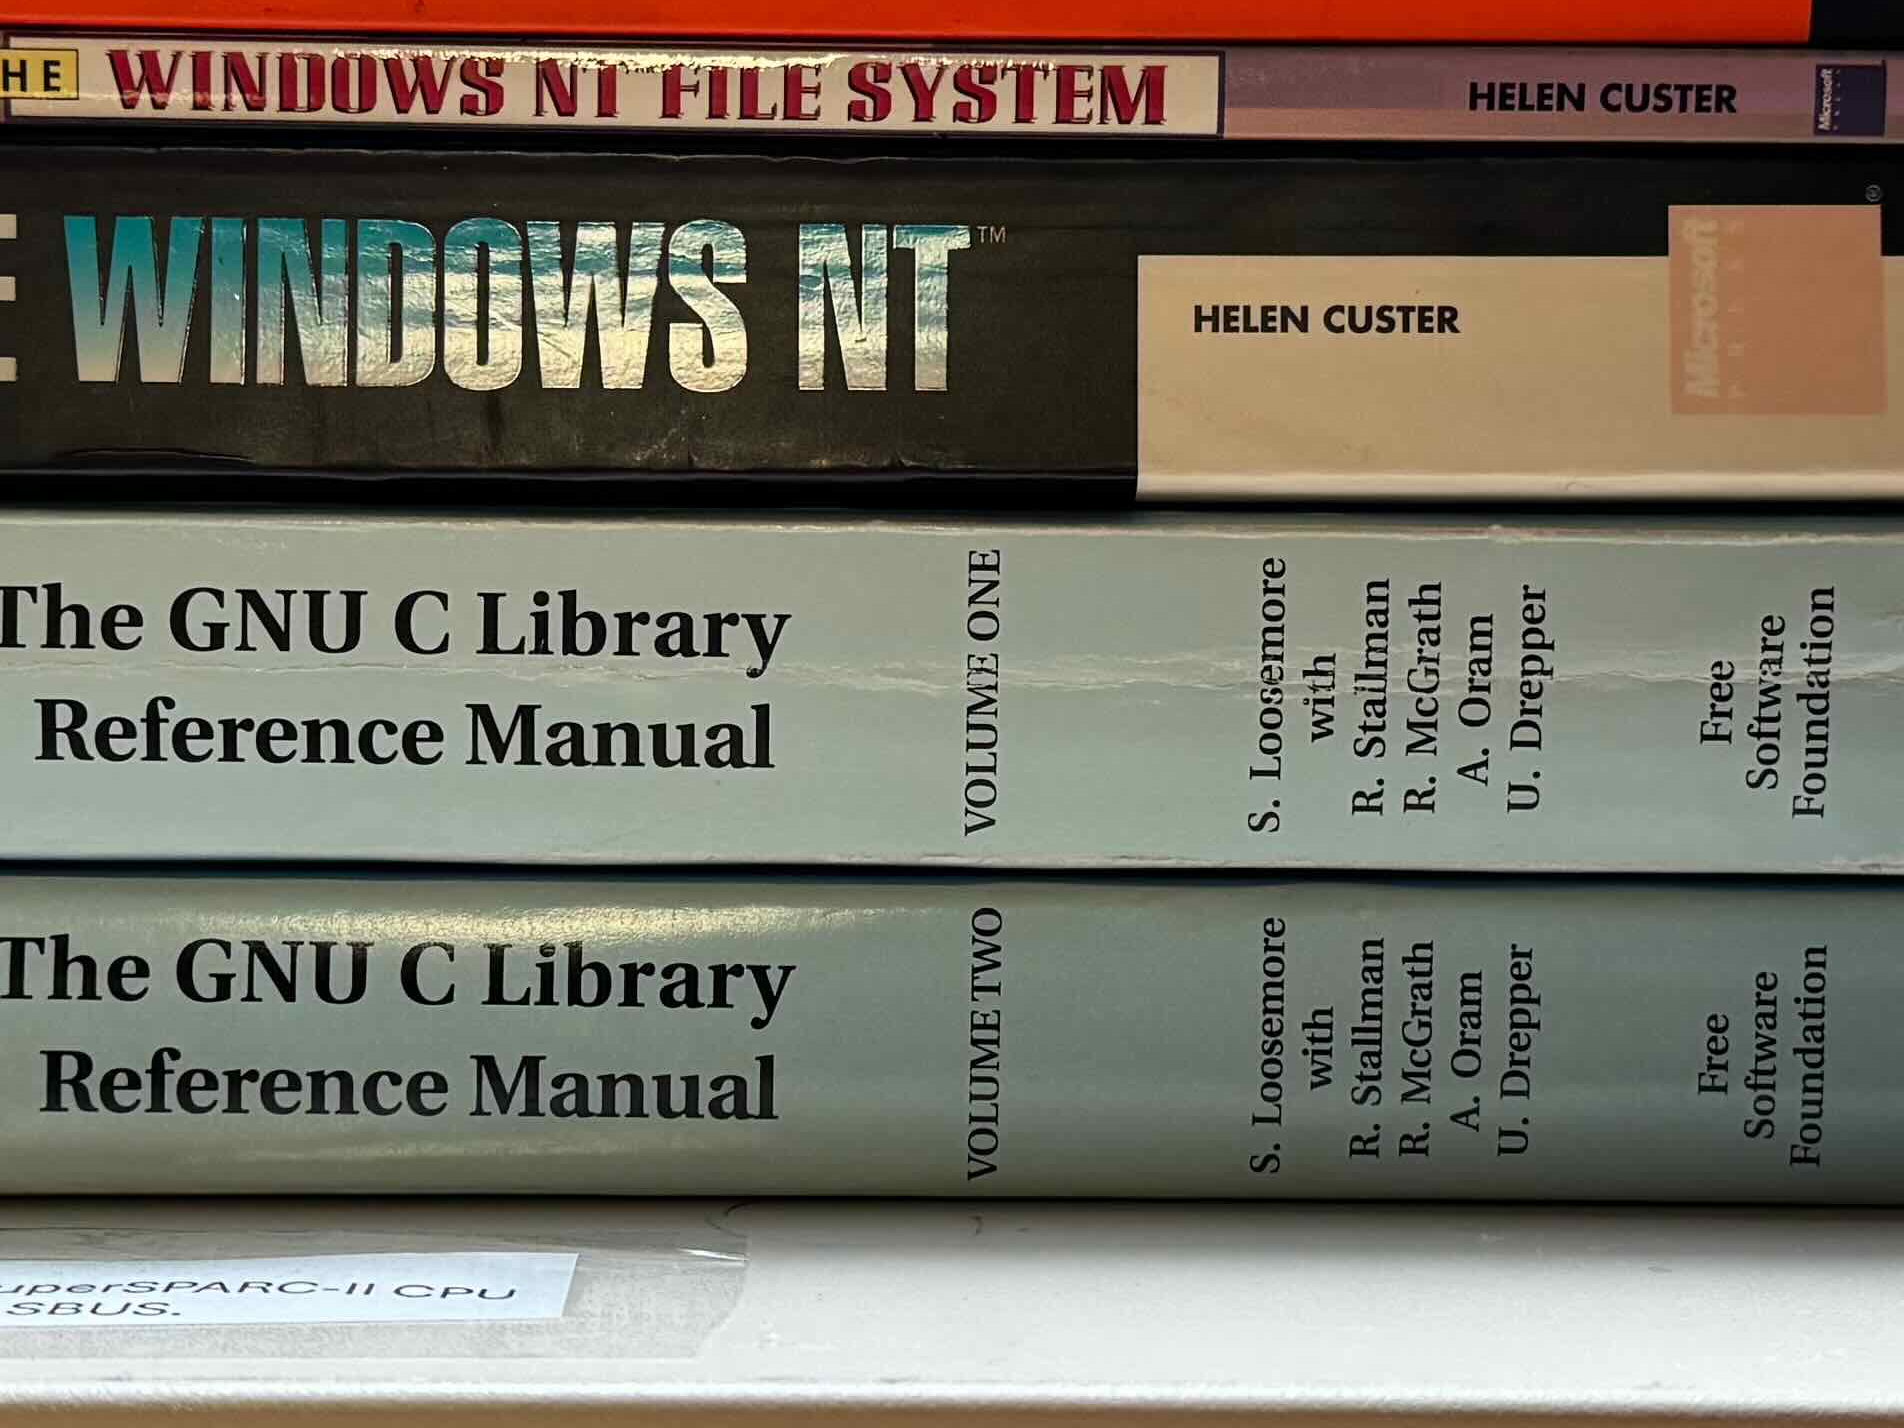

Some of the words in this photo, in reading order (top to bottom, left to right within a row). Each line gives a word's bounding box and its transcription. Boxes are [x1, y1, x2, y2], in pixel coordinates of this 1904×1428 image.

[106, 49, 506, 117] WINDOWS
[533, 59, 619, 118] NT
[660, 61, 822, 121] FILE
[846, 61, 1168, 125] SYSTEM
[1468, 82, 1586, 112] HELEN
[1599, 83, 1737, 114] CUSTER
[63, 215, 749, 394] WINDOWS
[796, 222, 971, 393] NT
[1193, 304, 1309, 334] HELEN
[1323, 304, 1459, 335] CUSTER
[1682, 219, 1718, 397] Microsoft
[168, 586, 368, 655] GNU
[394, 588, 452, 657] C
[475, 589, 793, 679] Library
[967, 549, 1001, 642] ONE
[1249, 556, 1287, 781] Loosemore
[1302, 652, 1337, 743] with
[1353, 577, 1390, 759] Stallman
[1405, 580, 1442, 756] McGrath
[1457, 612, 1494, 729] Oram
[1509, 584, 1555, 751] Drepper
[1699, 659, 1734, 746] Free
[1745, 613, 1786, 791] Software
[1791, 585, 1835, 819] Foundation
[33, 695, 445, 765] Reference
[464, 702, 776, 770] Manual
[964, 652, 999, 837] VOLUME
[1455, 747, 1489, 787] A.
[1248, 798, 1281, 834] S.
[1351, 778, 1385, 816] R.
[1403, 776, 1437, 814] R.
[1506, 771, 1541, 813] U.
[174, 936, 374, 1005] GNU
[398, 939, 457, 1008] C
[480, 941, 797, 1031] Library
[971, 907, 1003, 1002] TWO
[1251, 916, 1287, 1127] Loosemore
[1301, 1005, 1335, 1090] with
[1350, 937, 1385, 1107] Stallman
[1400, 939, 1435, 1106] McGrath
[1450, 968, 1484, 1078] Oram
[1499, 943, 1542, 1102] Drepper
[1698, 1012, 1731, 1097] Free
[1743, 970, 1780, 1141] Software
[1790, 944, 1828, 1168] Foundation
[37, 1046, 450, 1119] Reference
[468, 1053, 780, 1122] Manual
[967, 1009, 1001, 1181] VOLUME
[1449, 1094, 1482, 1133] A.
[1249, 1141, 1282, 1174] S.
[1349, 1123, 1382, 1160] R.
[1398, 1122, 1431, 1158] R.
[1497, 1116, 1530, 1157] U.
[4, 1302, 184, 1316] SBUS.
[391, 1284, 518, 1300] CPU
